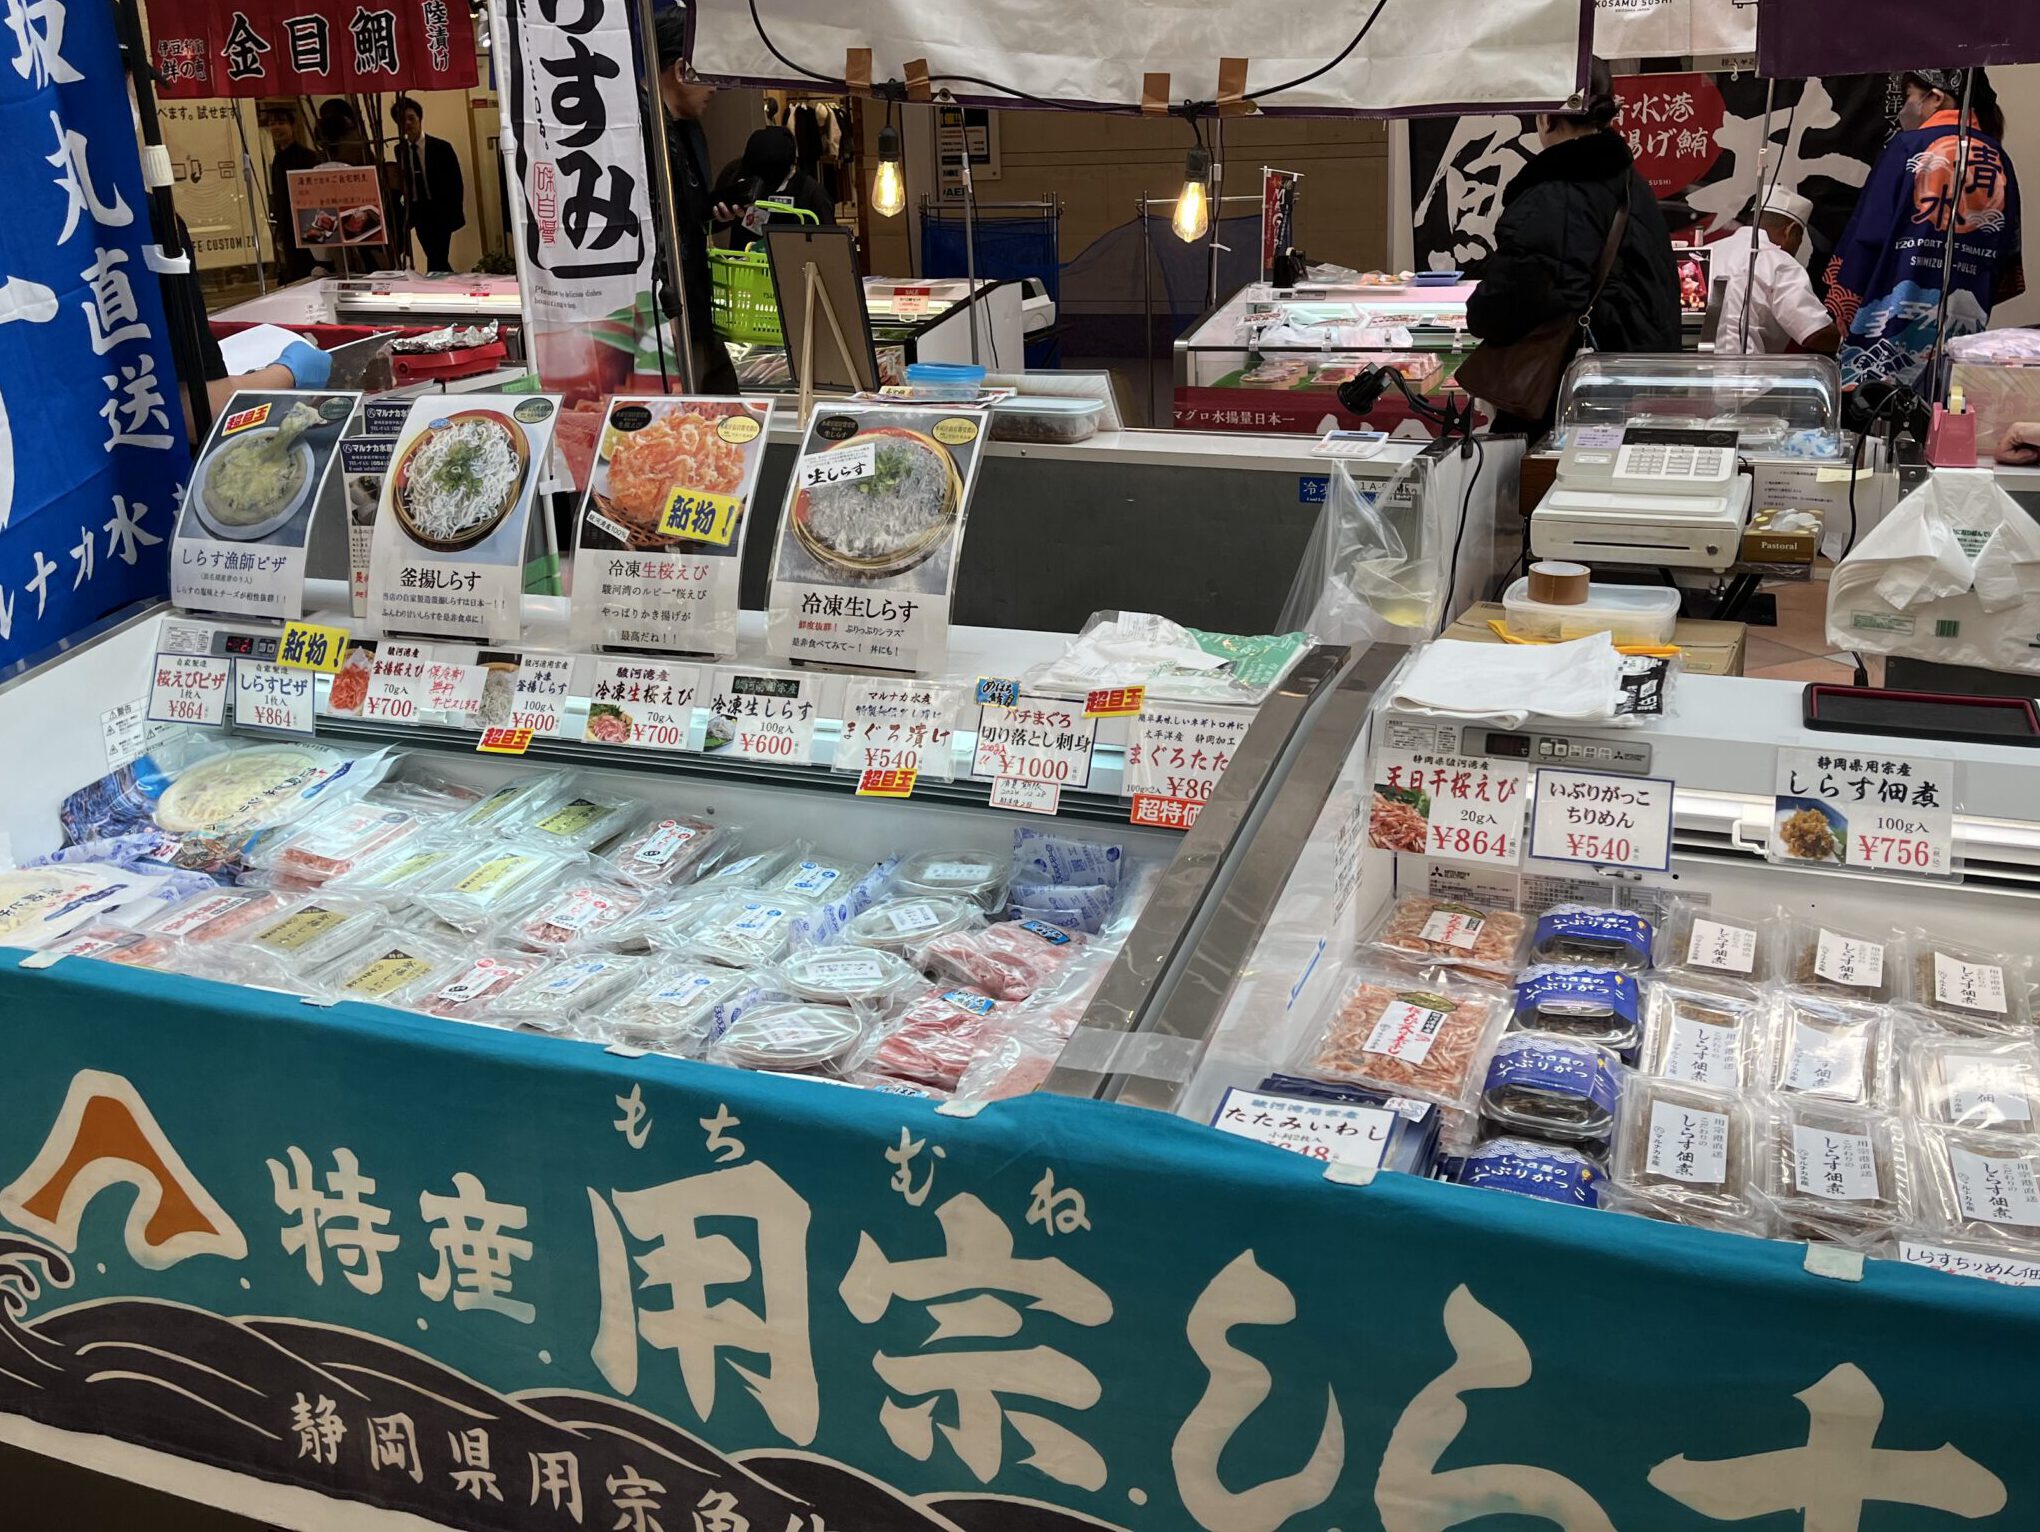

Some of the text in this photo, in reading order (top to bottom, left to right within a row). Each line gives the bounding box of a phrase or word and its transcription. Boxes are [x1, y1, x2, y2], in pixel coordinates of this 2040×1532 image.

[221, 7, 401, 80] 金目鯛
[1761, 541, 1798, 551] Pastoral
[0, 482, 190, 641] ナカ水
[181, 548, 287, 573] しらす漁師ピザ
[608, 559, 709, 581] 冷凍生桜えび
[399, 567, 482, 592] 釜揚しらす
[601, 607, 691, 622] やっぱりかき揚げが
[801, 592, 919, 623] 冷凍生しらす
[156, 669, 226, 691] 桜えびピザ
[240, 673, 308, 697] しらすピザ
[615, 666, 671, 682] 駿河湾産
[516, 680, 568, 695] 釜揚しらす
[594, 680, 694, 706] 冷凍生桜えび
[868, 692, 932, 704] マルナカ水産
[1085, 687, 1143, 713] 超目玉
[168, 700, 203, 720] ¥864
[254, 705, 292, 727] ¥864
[367, 697, 412, 718] ¥700
[647, 711, 675, 724] 70g入
[710, 693, 814, 722] 冷凍生しらす
[1004, 708, 1072, 729] バチまぐろ
[512, 711, 556, 731] ¥600
[759, 721, 795, 735] 100g入
[481, 728, 532, 747] 超目玉
[633, 723, 679, 745] ¥700
[740, 732, 792, 756] ¥600
[843, 722, 951, 748] まぐろ漬け
[981, 725, 1092, 753] 切り落とし刺身
[864, 747, 918, 769] ¥540
[998, 755, 1069, 781] ¥1000
[1129, 743, 1229, 772] まぐろたた
[1413, 754, 1490, 771] 静岡県駿河湾産
[1817, 755, 1913, 777] 静岡県用宗産
[861, 768, 916, 793] 超目玉
[1167, 776, 1213, 800] ¥86
[1386, 765, 1521, 804] 天日干桜えび
[1790, 770, 1941, 808] しらす佃煮
[1549, 781, 1652, 807] いぶりがっこ
[1136, 797, 1204, 825] 超特価
[1460, 808, 1498, 825] 20g入
[1567, 806, 1635, 829] ちりめん
[1876, 816, 1930, 834] 100g入
[1431, 825, 1508, 858] ¥864
[1566, 833, 1631, 862] ¥540
[1858, 835, 1930, 867] ¥756
[1711, 928, 1731, 966] しらす佃煮
[1838, 942, 1855, 982] しらす佃煮
[1960, 966, 1978, 1006] しらす佃煮
[1690, 1029, 1710, 1083] しらす佃煮
[1226, 1107, 1387, 1142] たたみいわし
[1257, 1140, 1330, 1161] 48
[1676, 1114, 1696, 1177] しらす佃煮
[613, 1082, 1092, 1237] もち むね
[1823, 1136, 1846, 1195] しらす佃煮
[1983, 1162, 2013, 1220] しらす佃煮
[265, 1145, 536, 1324] 特産
[585, 1160, 1114, 1493] 用宗
